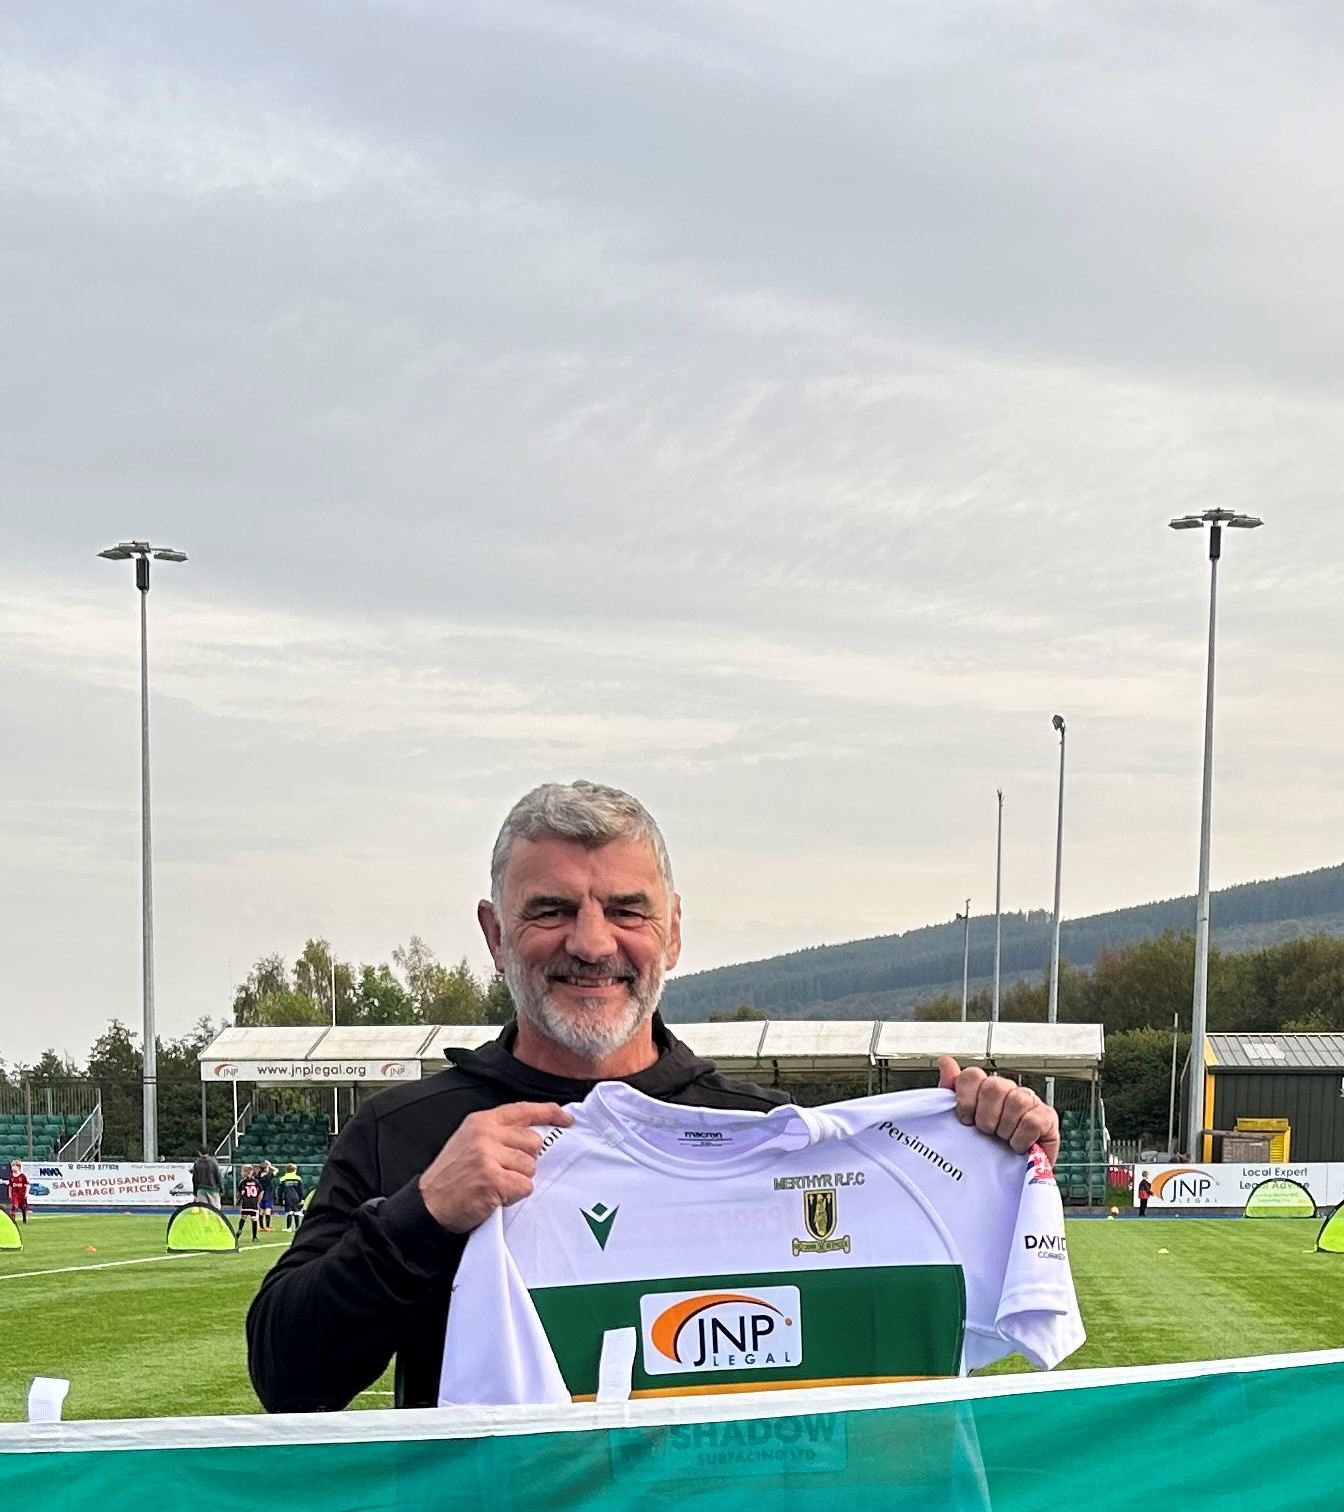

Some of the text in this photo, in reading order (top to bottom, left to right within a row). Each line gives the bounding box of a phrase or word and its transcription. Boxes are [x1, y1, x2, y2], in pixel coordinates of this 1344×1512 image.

[223, 1066, 239, 1078] JNP
[257, 1064, 366, 1077] www.jnplegal.org
[390, 1066, 406, 1077] JNP
[878, 1120, 964, 1182] Persimmon
[774, 1172, 834, 1190] MERTHYR
[1242, 1167, 1308, 1179] Local Expert
[52, 1173, 176, 1190] SAVE THOUSANDS ON
[69, 1183, 161, 1198] GARAGE PRICES
[245, 1185, 258, 1198] 10
[1170, 1178, 1211, 1203] JNP
[693, 1315, 775, 1368] JNP
[712, 1351, 792, 1367] LEGAL
[671, 1414, 837, 1449] SHADOW
